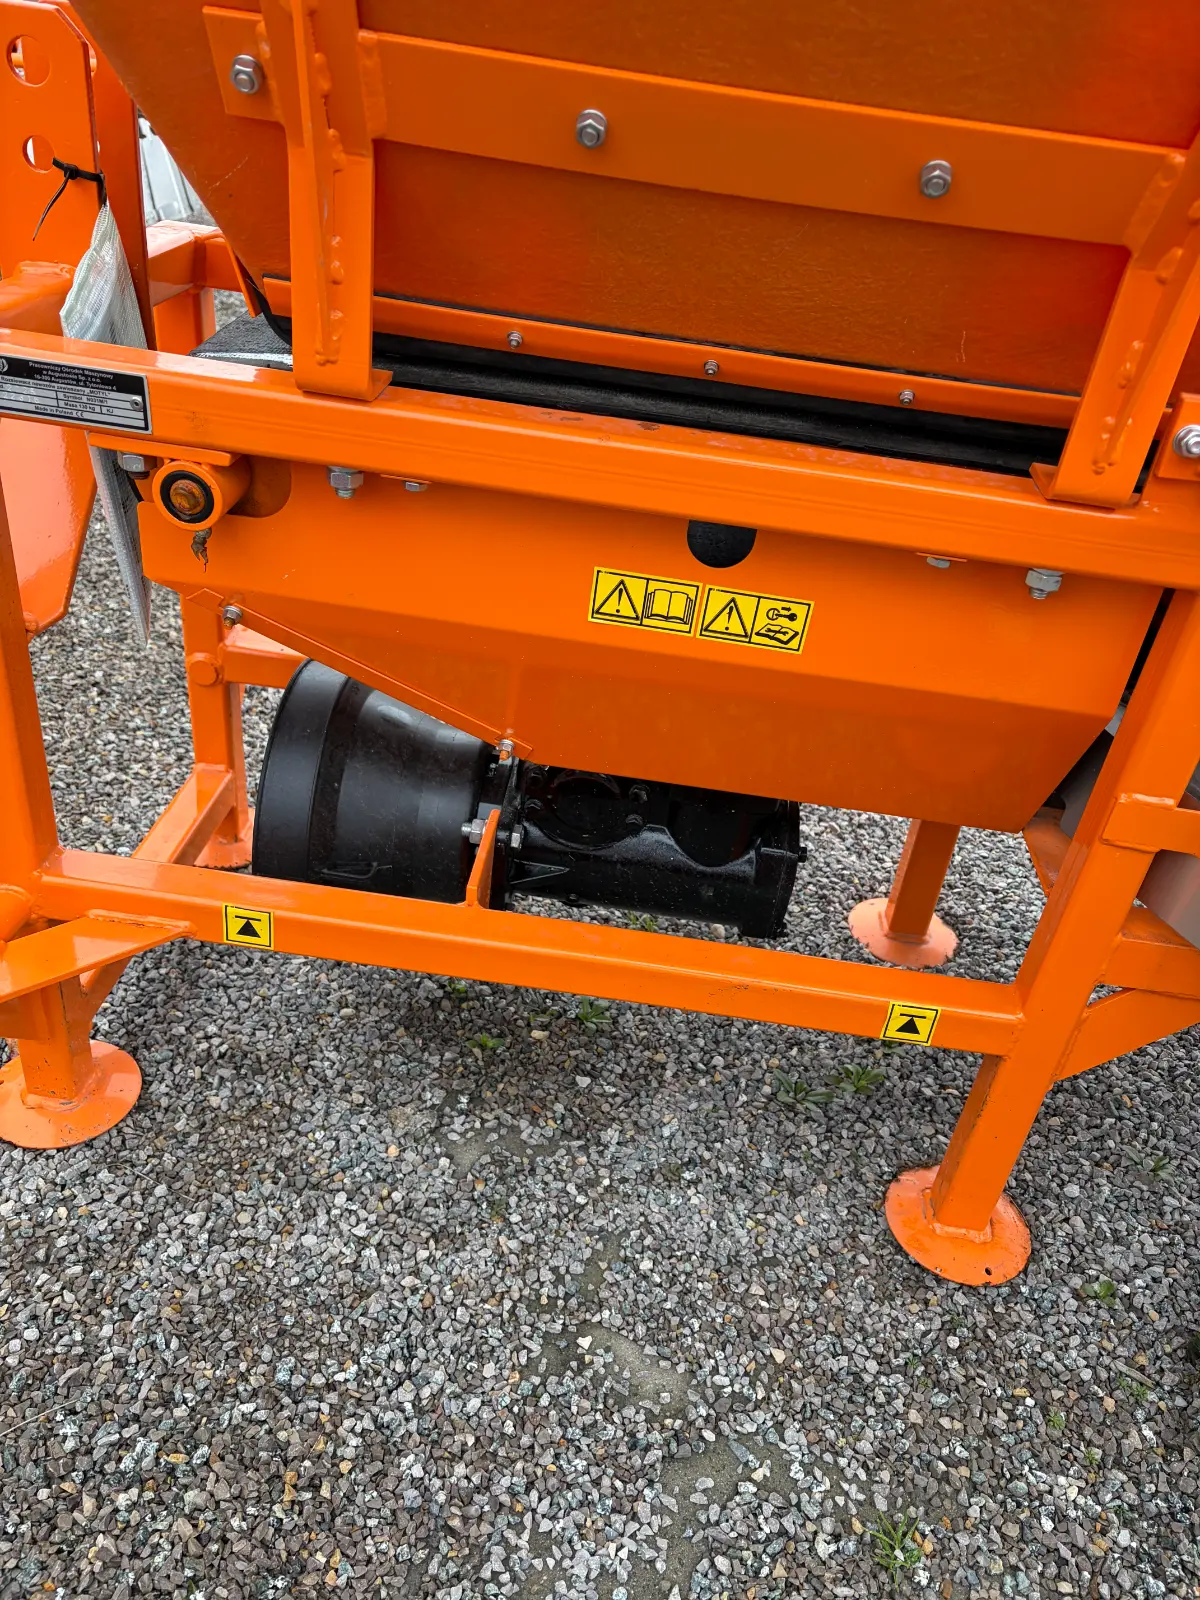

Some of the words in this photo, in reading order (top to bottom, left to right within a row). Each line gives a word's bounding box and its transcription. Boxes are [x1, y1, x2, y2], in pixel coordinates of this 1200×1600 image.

[83, 369, 114, 380] Maszynowy
[62, 393, 83, 401] Symbol
[55, 408, 74, 416] Poland
